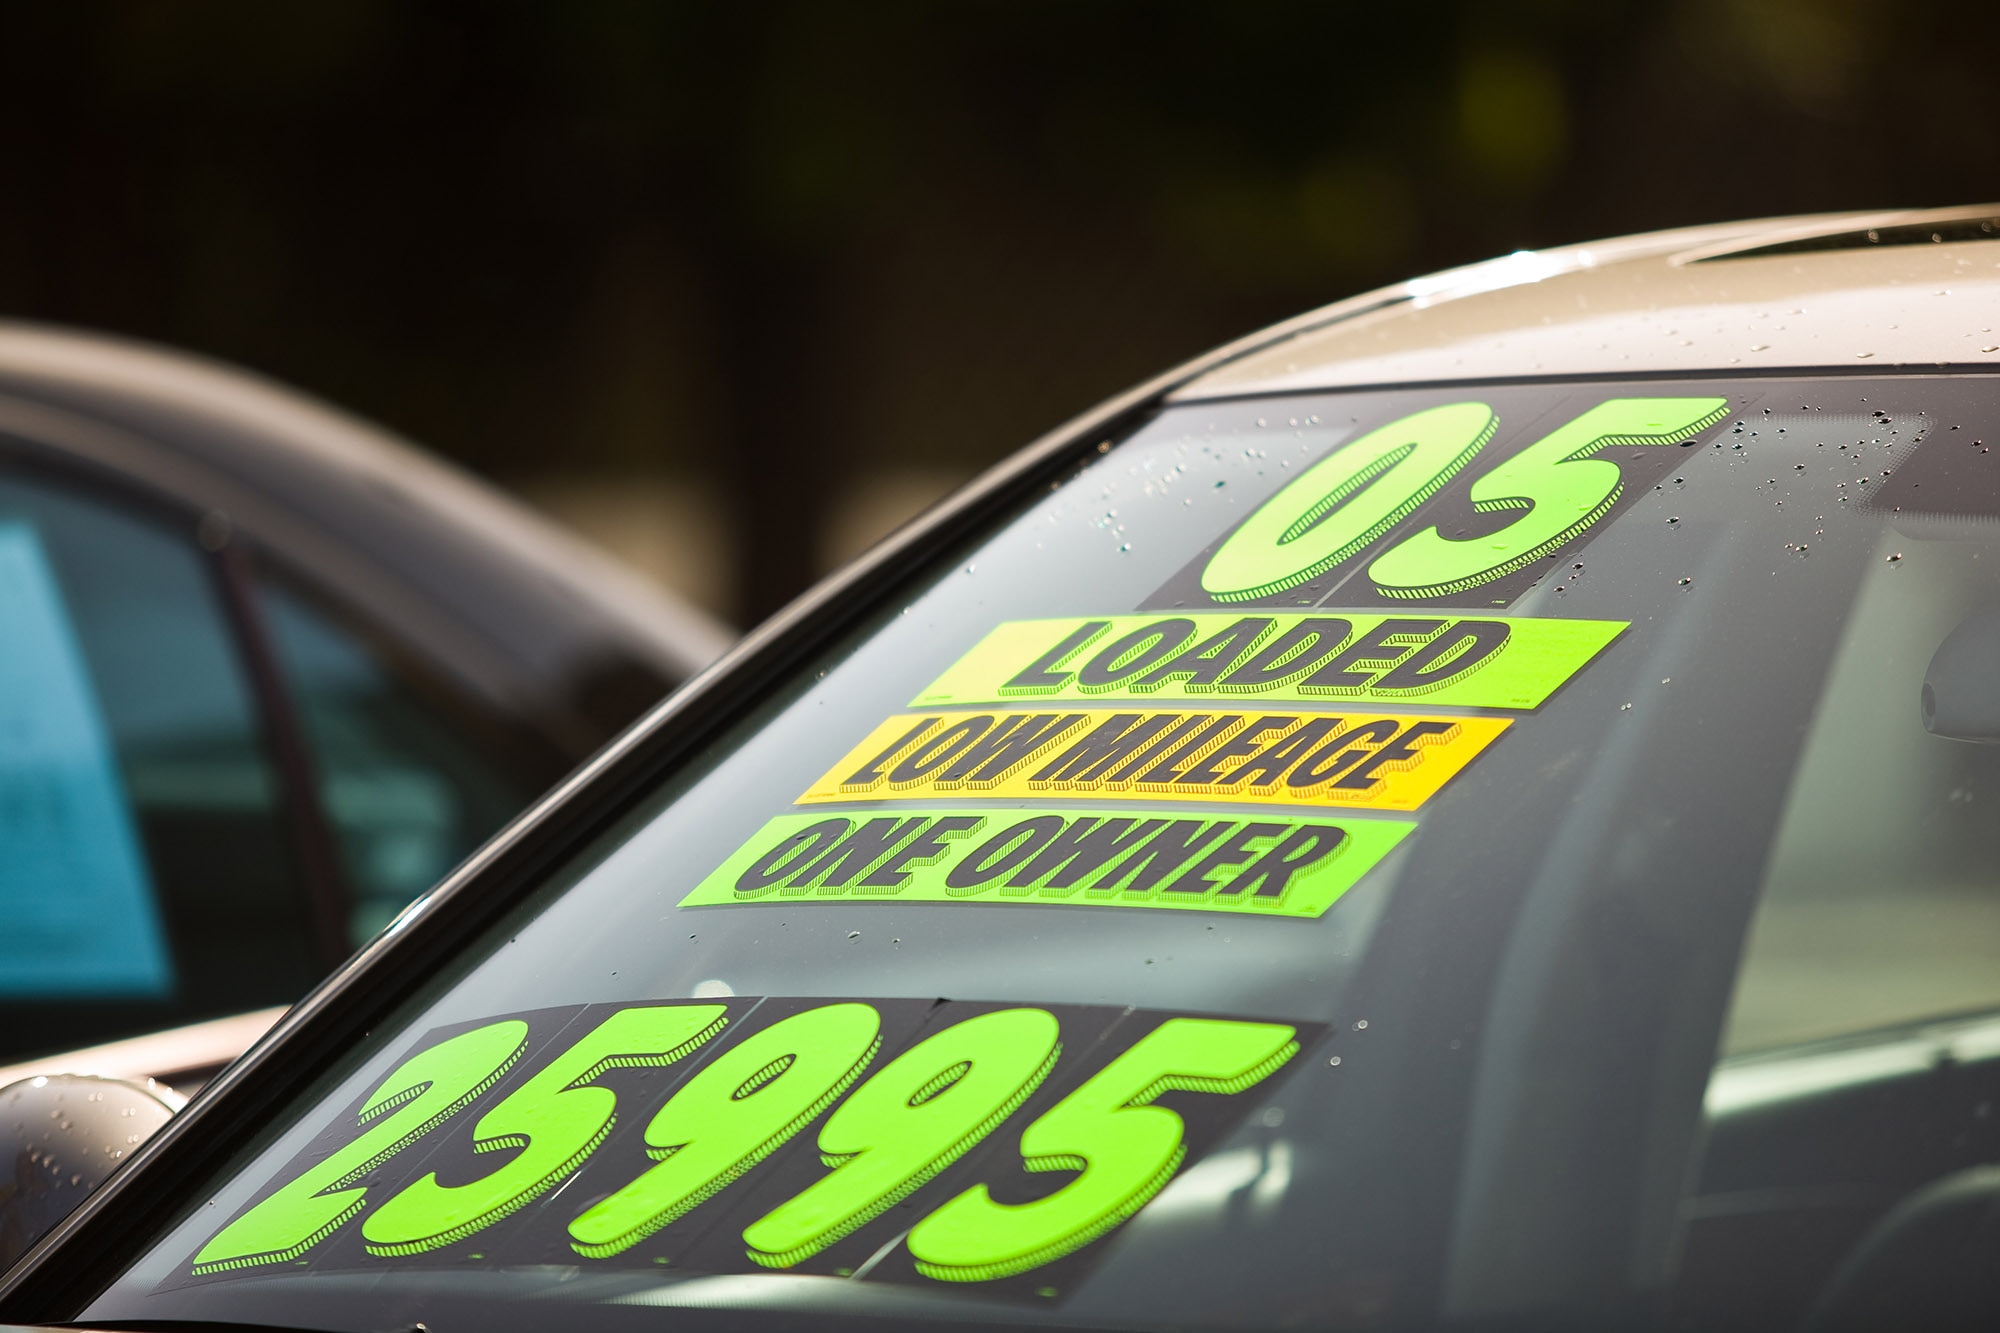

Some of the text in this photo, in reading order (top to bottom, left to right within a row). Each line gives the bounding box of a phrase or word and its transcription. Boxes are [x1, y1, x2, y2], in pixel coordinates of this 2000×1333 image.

[1201, 398, 1730, 602] 05
[998, 617, 1511, 697] LOADED
[839, 714, 1462, 801] LOW MILEAGE
[734, 815, 1354, 908] ONE OWNER
[191, 1002, 1301, 1283] 25995
